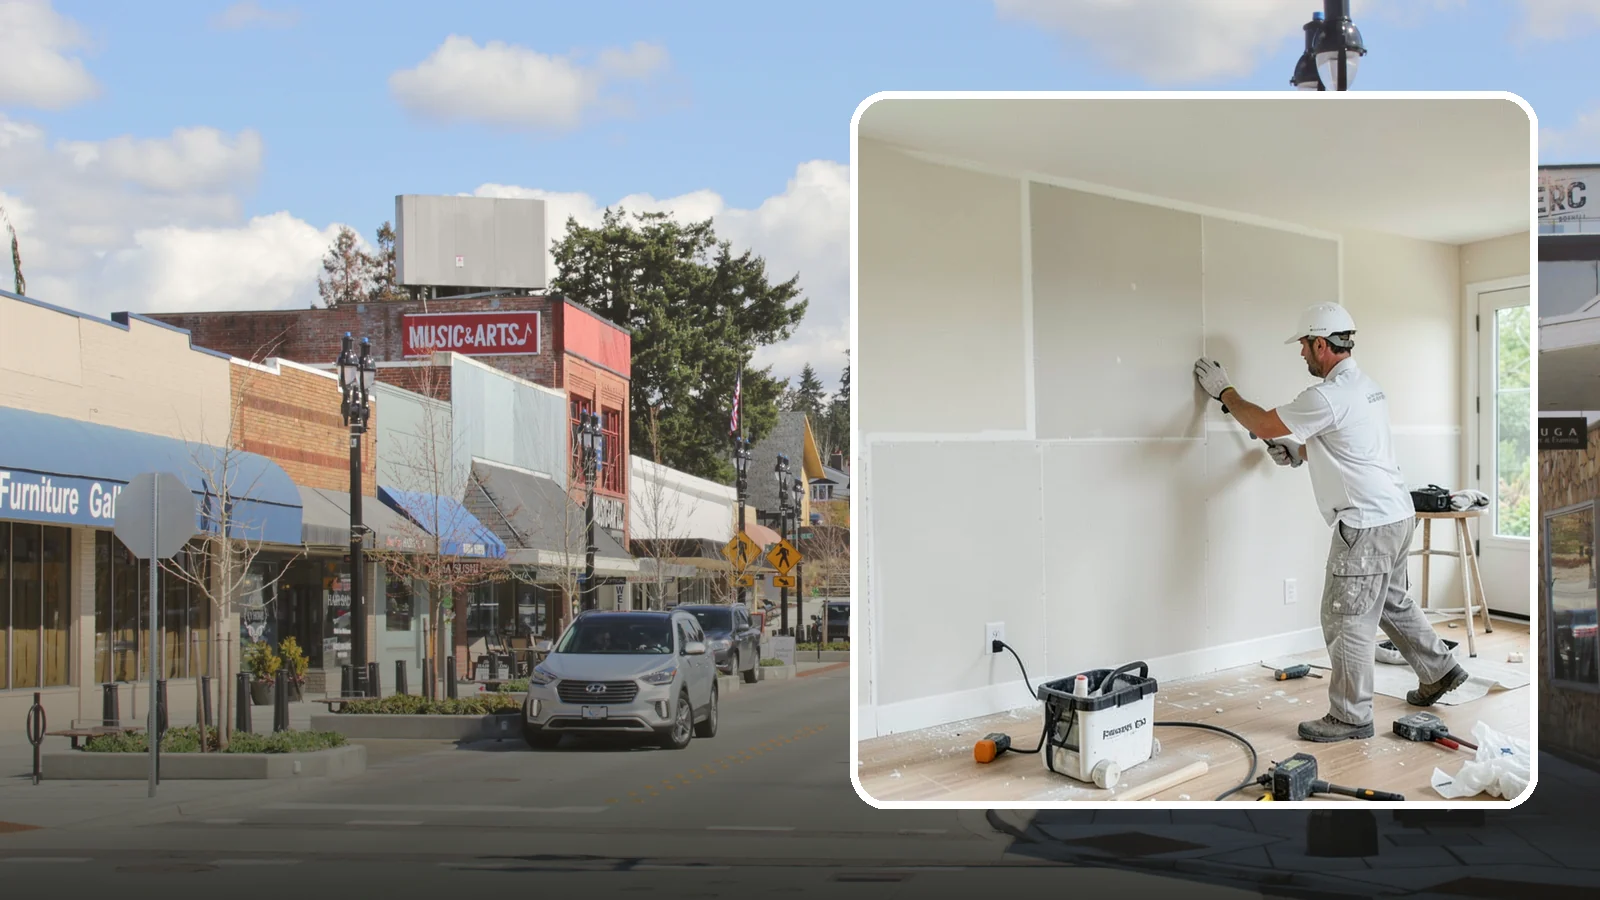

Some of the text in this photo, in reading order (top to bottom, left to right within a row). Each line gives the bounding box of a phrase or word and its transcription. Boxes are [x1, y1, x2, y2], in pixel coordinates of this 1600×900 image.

[409, 323, 519, 348] MUSIC&ARTS
[0, 472, 121, 519] Furniture Gal
[453, 562, 479, 574] SUSHI
